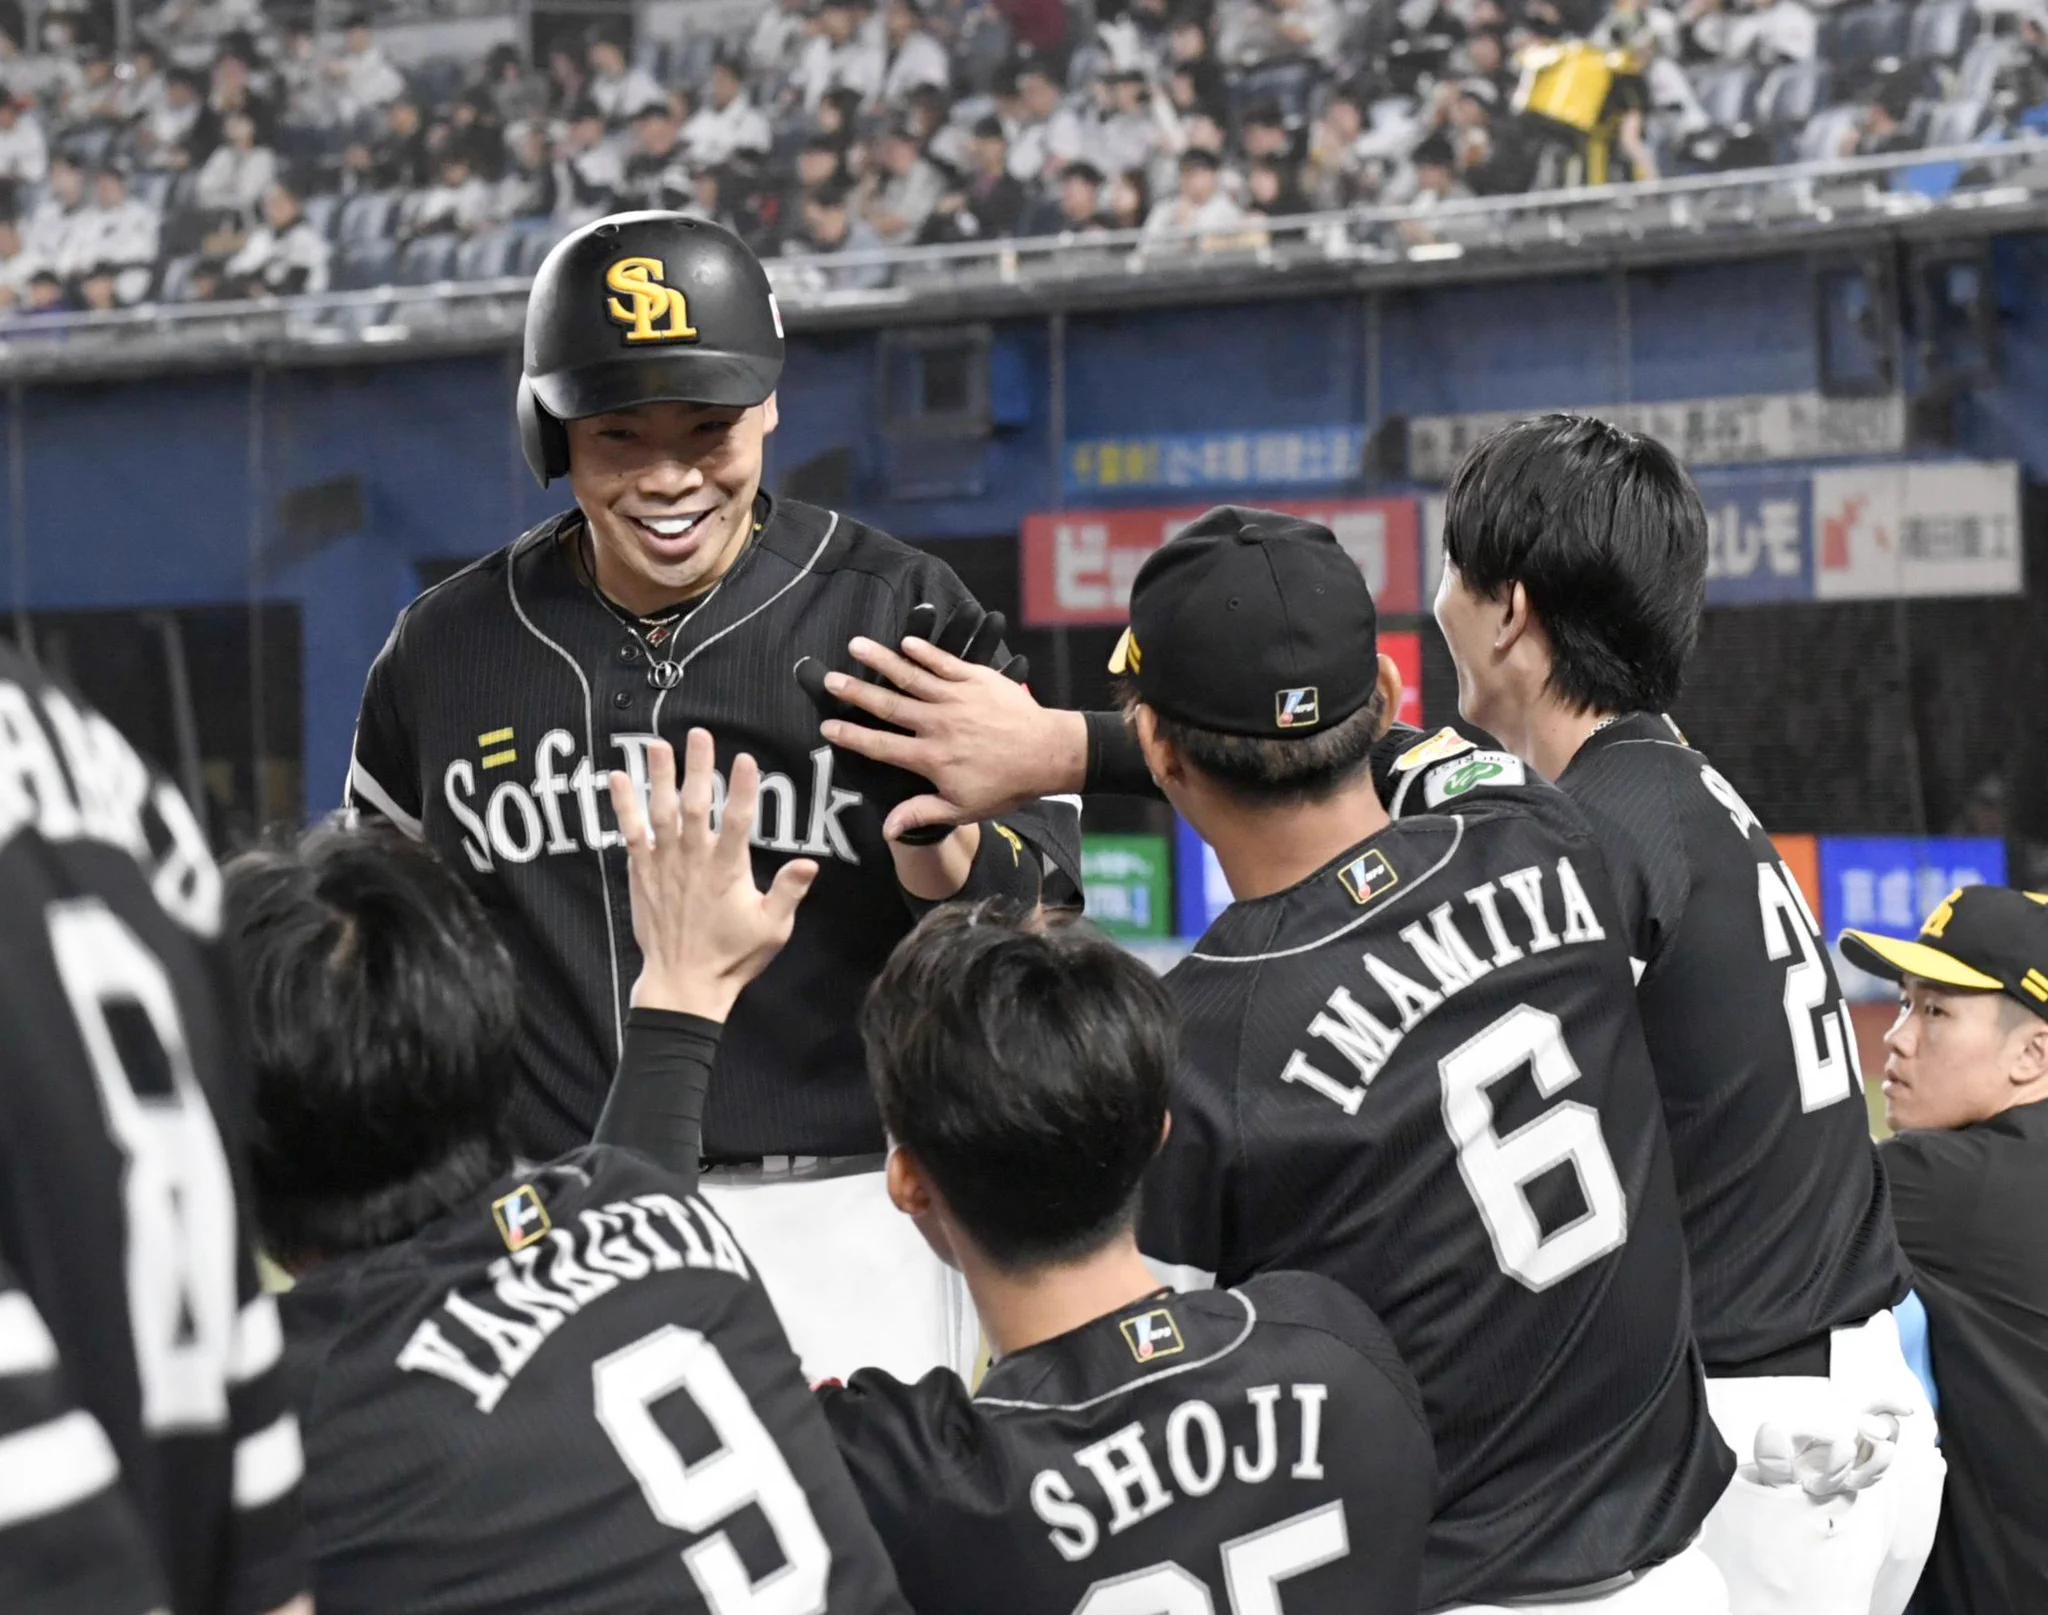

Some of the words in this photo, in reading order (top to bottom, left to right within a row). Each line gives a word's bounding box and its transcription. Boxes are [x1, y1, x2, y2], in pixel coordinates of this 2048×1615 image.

[1700, 764, 1764, 840] S
[1280, 856, 1607, 1116] IMAMIYA
[1757, 860, 1866, 1114] 2
[1437, 1002, 1628, 1294] 6
[592, 1323, 832, 1615] 9
[1030, 1383, 1328, 1562] SHOJI
